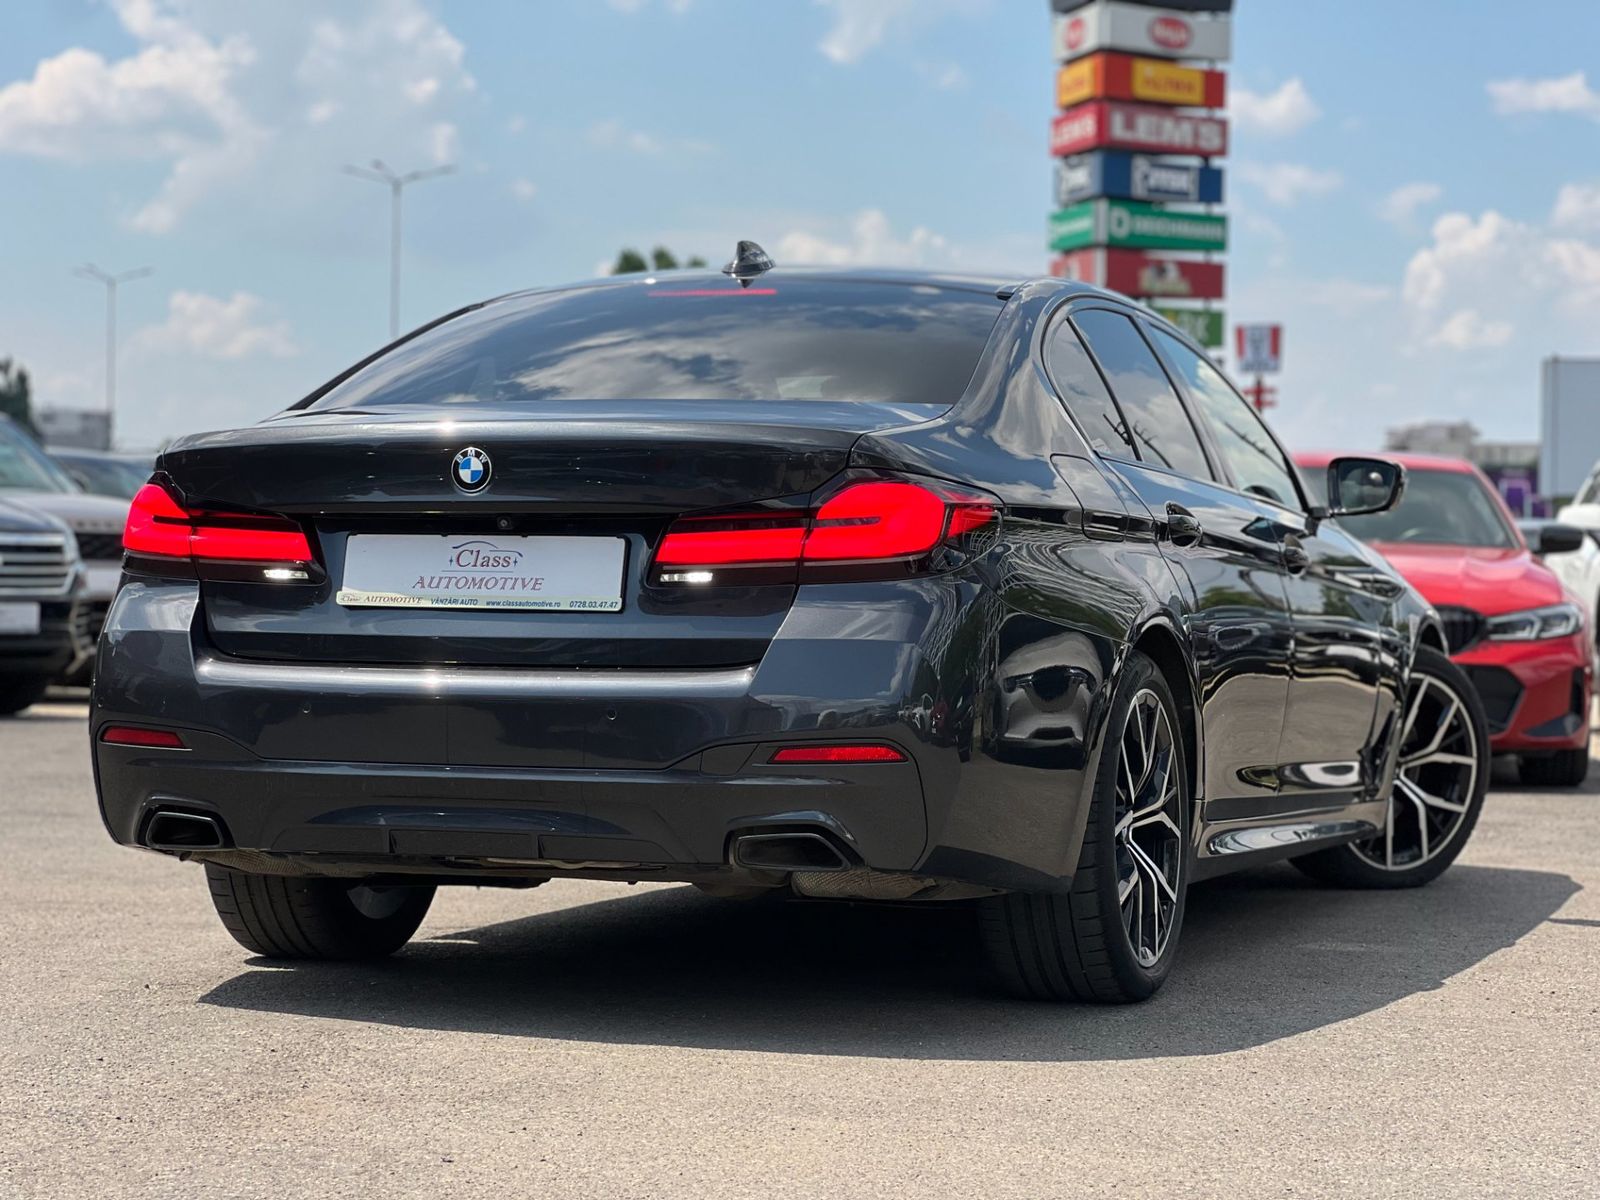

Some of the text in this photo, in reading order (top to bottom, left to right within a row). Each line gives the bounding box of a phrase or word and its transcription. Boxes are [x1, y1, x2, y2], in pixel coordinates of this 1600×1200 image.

[455, 449, 488, 463] BMW
[456, 549, 511, 568] Class
[412, 575, 545, 591] AUTOMOTIVE
[364, 595, 424, 604] AUTOMOTIVE
[460, 598, 478, 606] AUTO
[486, 600, 561, 608] www.classautomotive.ro
[569, 600, 618, 608] 0728.03.47.47
